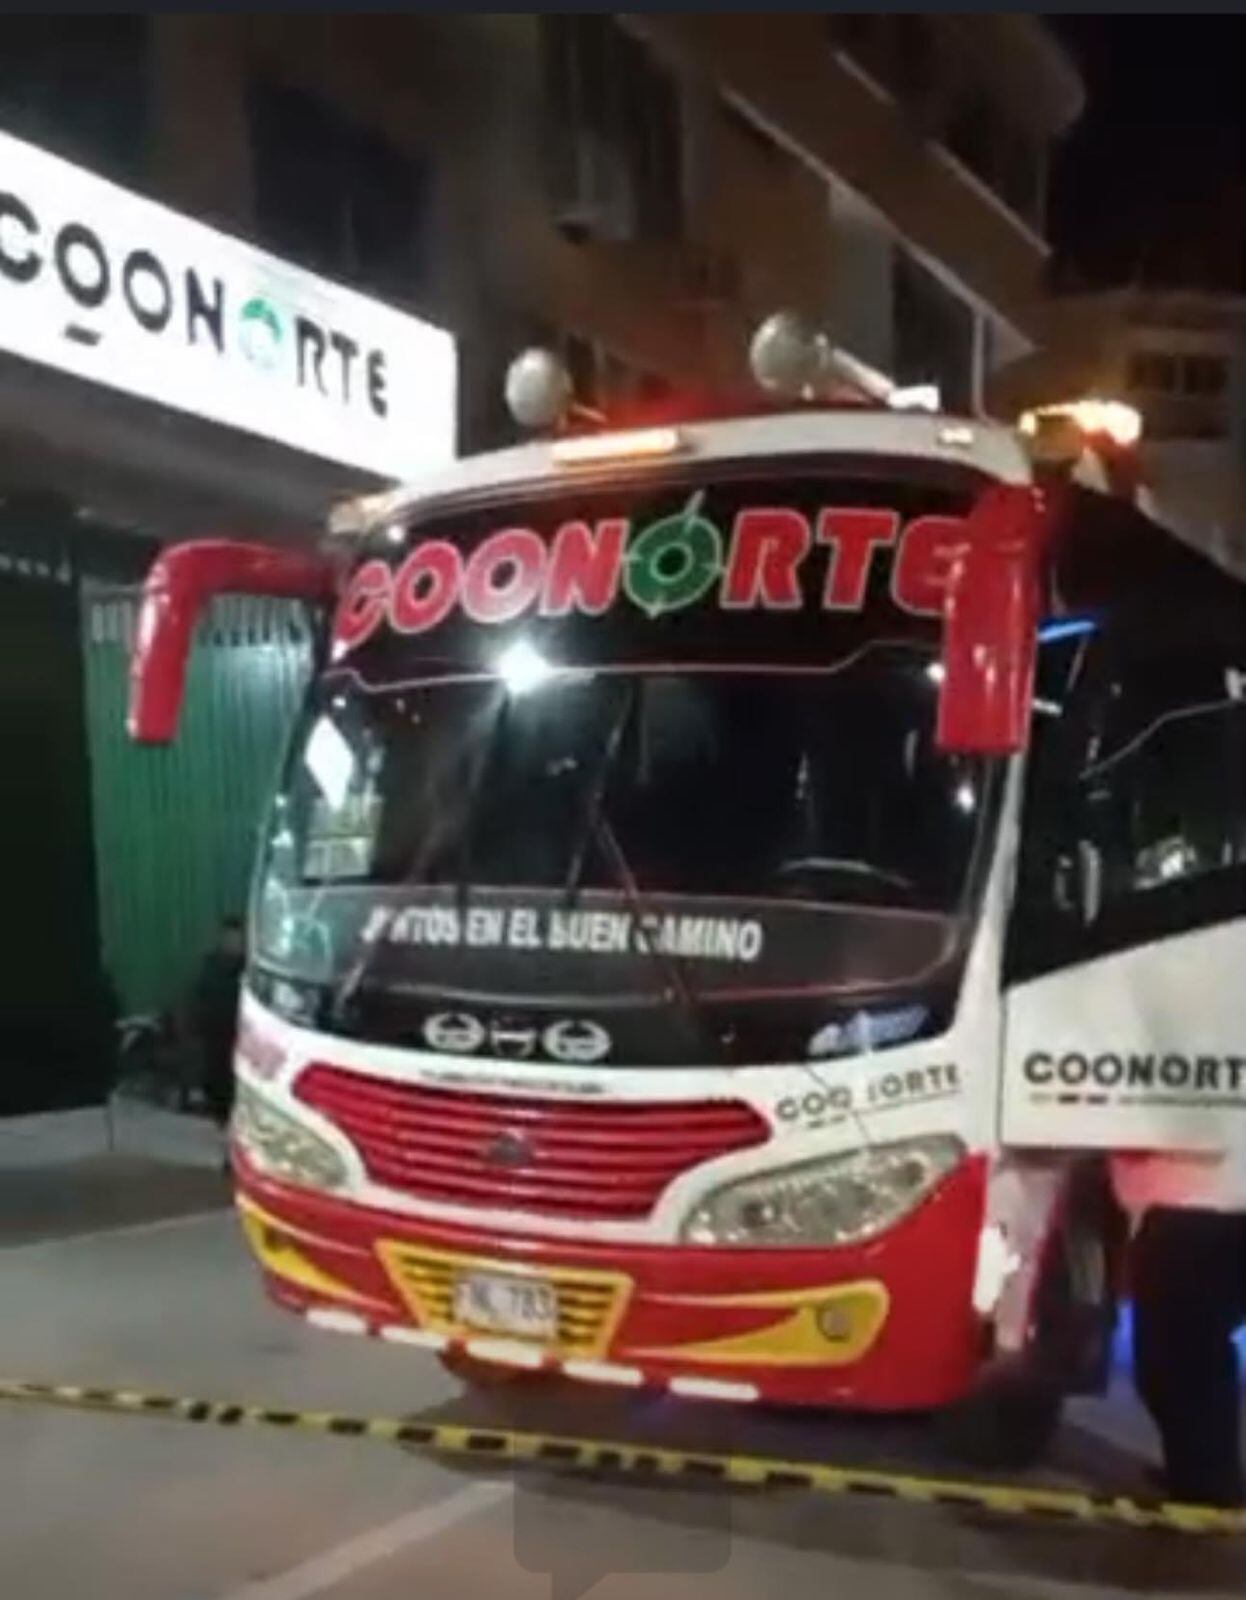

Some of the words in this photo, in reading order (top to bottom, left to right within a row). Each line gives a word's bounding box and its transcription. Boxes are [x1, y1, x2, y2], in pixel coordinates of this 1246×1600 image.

[0, 192, 388, 419] COONORTE
[332, 500, 966, 650] COONORTE
[465, 907, 502, 946] EN
[509, 908, 541, 947] EL
